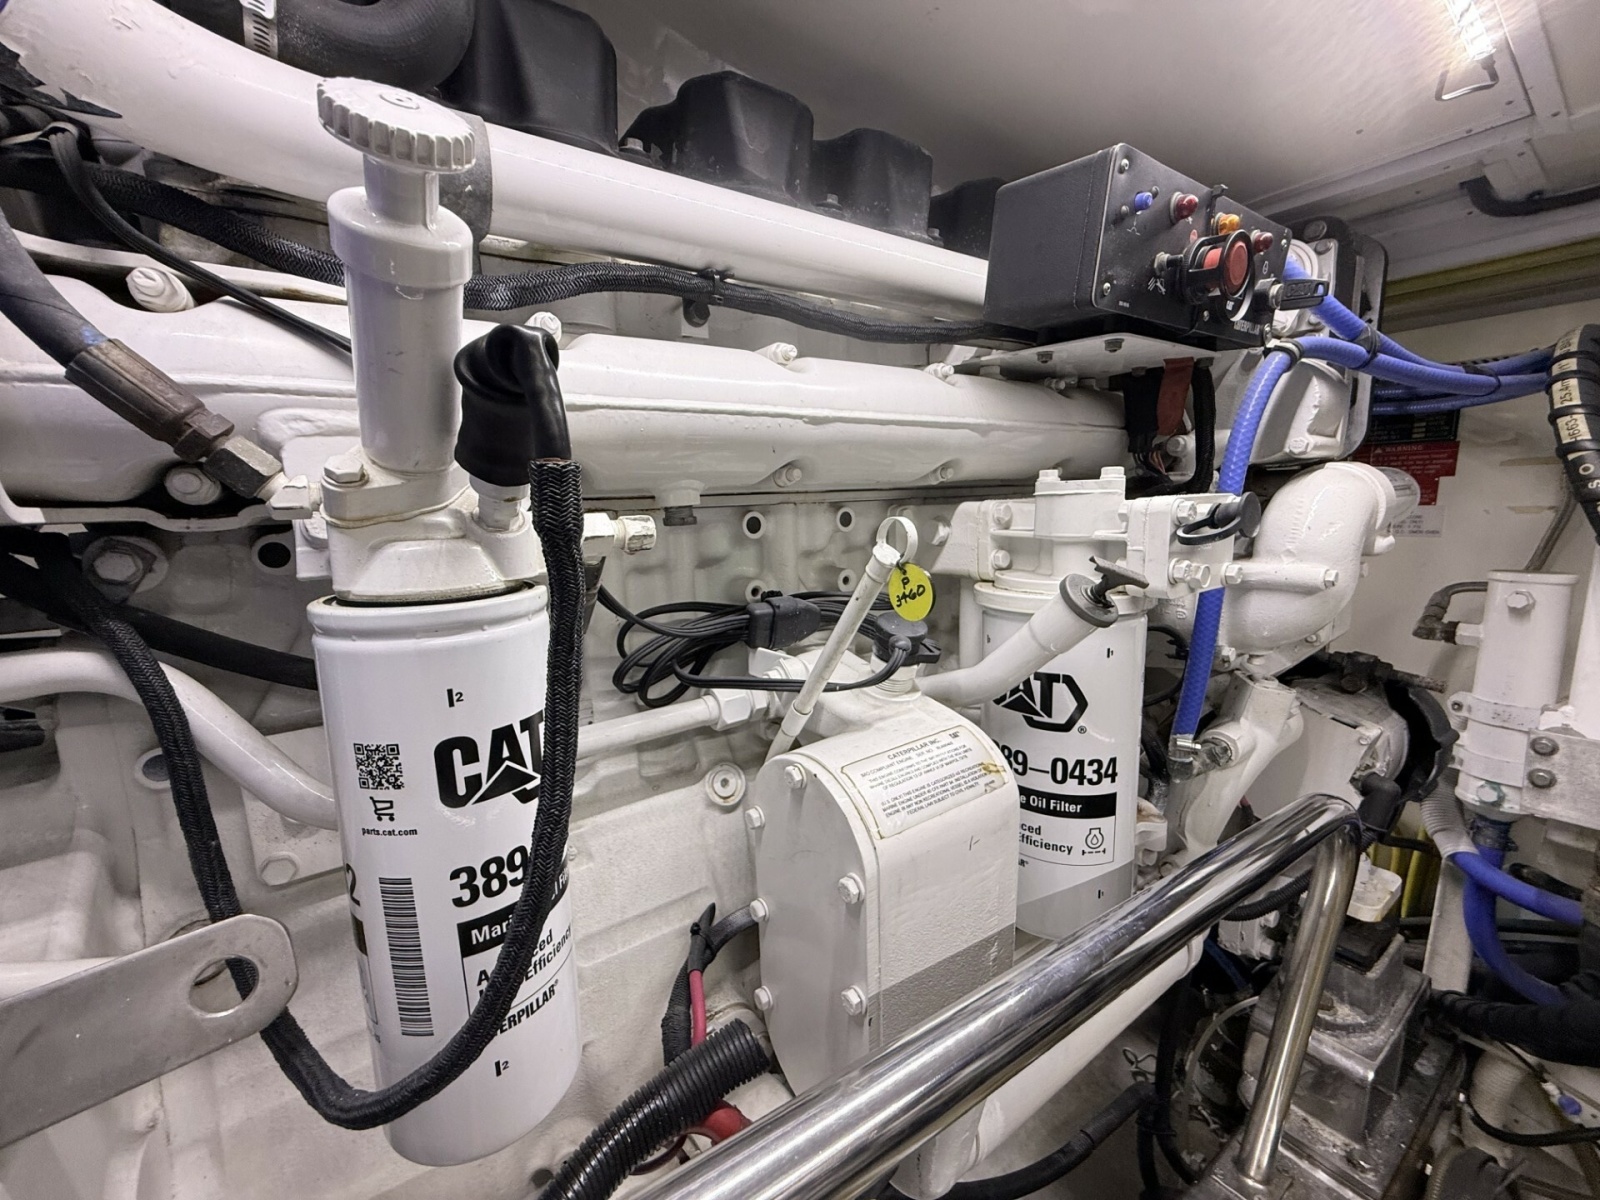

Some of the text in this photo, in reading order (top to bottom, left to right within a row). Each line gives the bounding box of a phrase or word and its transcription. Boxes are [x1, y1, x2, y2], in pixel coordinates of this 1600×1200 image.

[886, 741, 929, 760] CATERPILLAR
[1029, 795, 1046, 808] Oil
[1050, 799, 1082, 813] Filter
[361, 827, 418, 836] parts.cat.com
